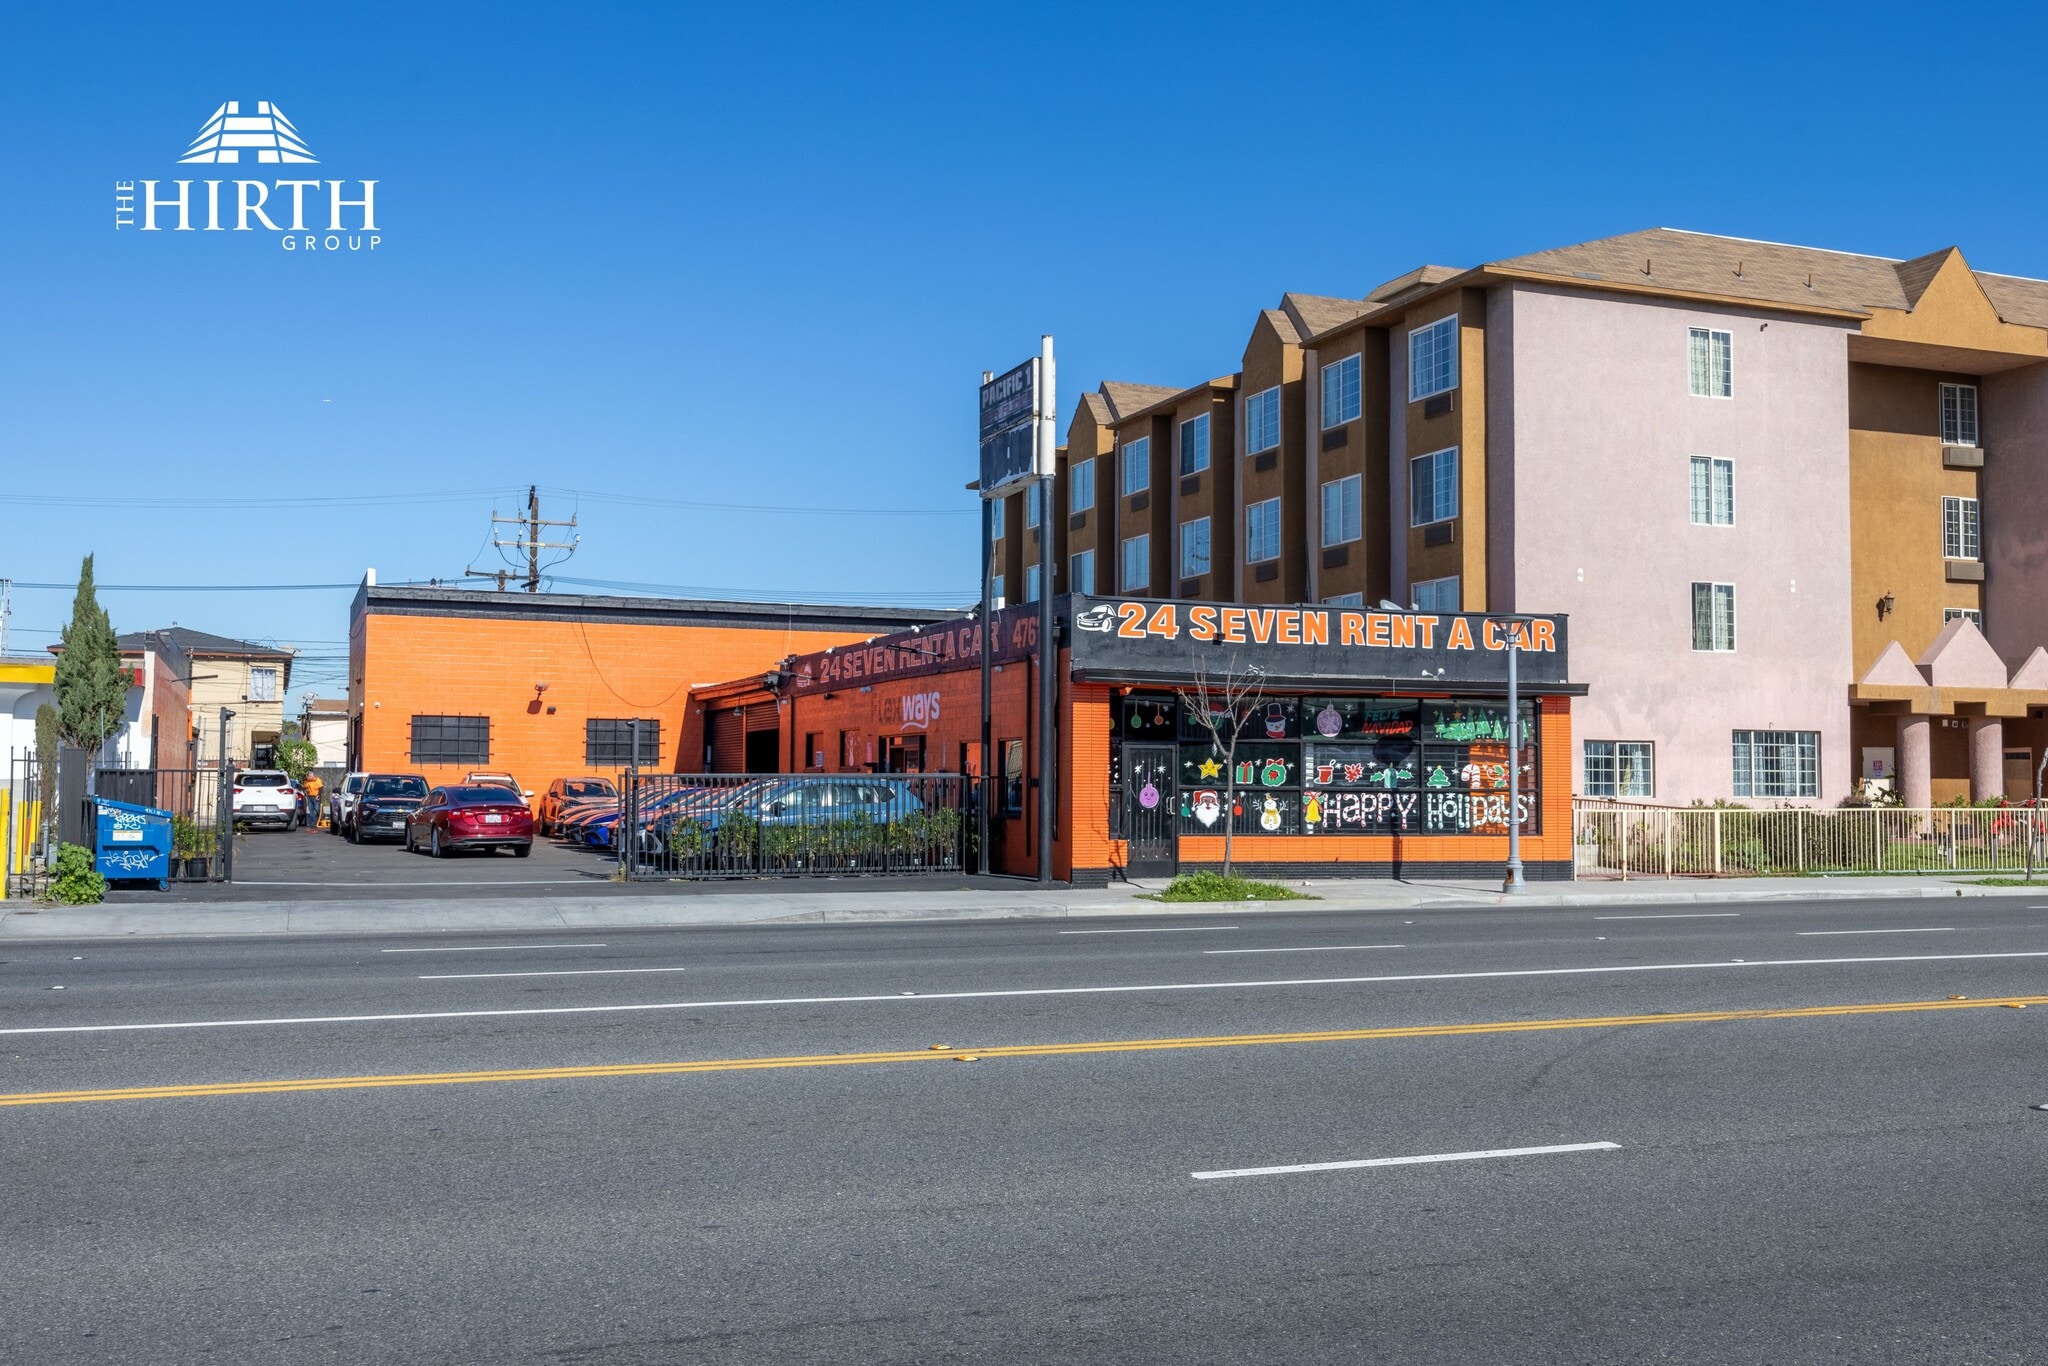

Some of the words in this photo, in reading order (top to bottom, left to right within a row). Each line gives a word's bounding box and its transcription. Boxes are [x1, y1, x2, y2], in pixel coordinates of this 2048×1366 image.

[982, 371, 1023, 409] PACIFIC
[1117, 602, 1180, 640] 24
[1189, 606, 1329, 645] SEVEN
[1340, 612, 1439, 649] RENT
[1447, 617, 1475, 650] A
[1483, 617, 1556, 652] CAR
[820, 656, 841, 684] 24
[843, 645, 895, 679] SEVEN
[899, 633, 945, 669] RENT
[945, 630, 956, 661] A
[1013, 615, 1040, 649] 476
[1361, 720, 1414, 735] NAVIDAD
[1364, 709, 1400, 721] FELIZ
